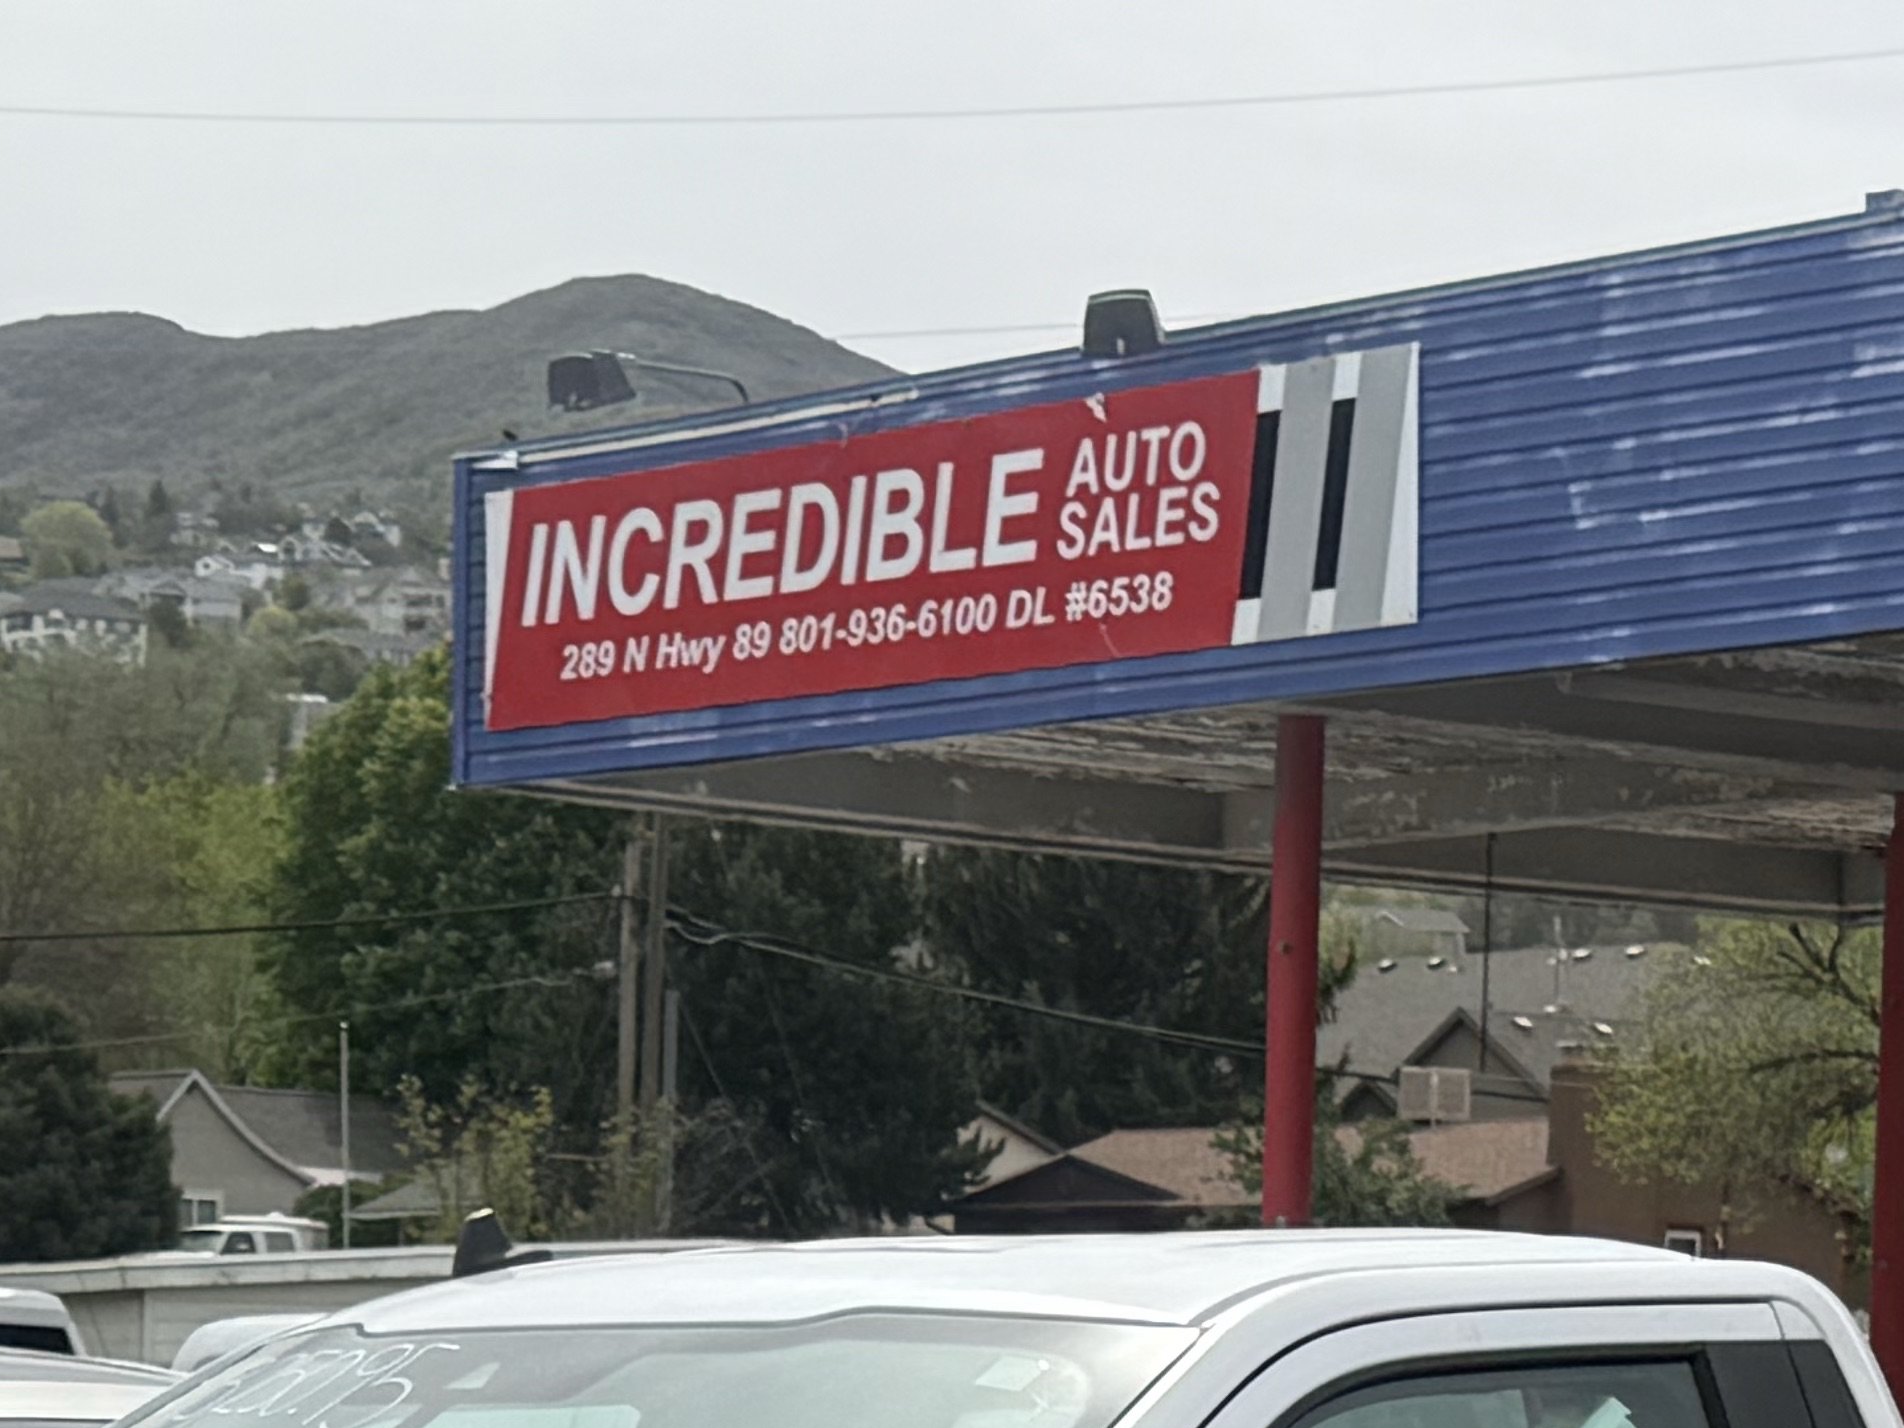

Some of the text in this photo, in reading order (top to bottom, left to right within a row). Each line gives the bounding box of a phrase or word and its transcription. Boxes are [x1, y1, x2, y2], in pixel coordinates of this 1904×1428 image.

[1066, 420, 1206, 497] AUTO
[521, 448, 1044, 627] INCREDIBLE
[1056, 482, 1220, 560] SALES
[560, 571, 1174, 680] 289 N Hwy 89 801-936-6100 DL #6538
